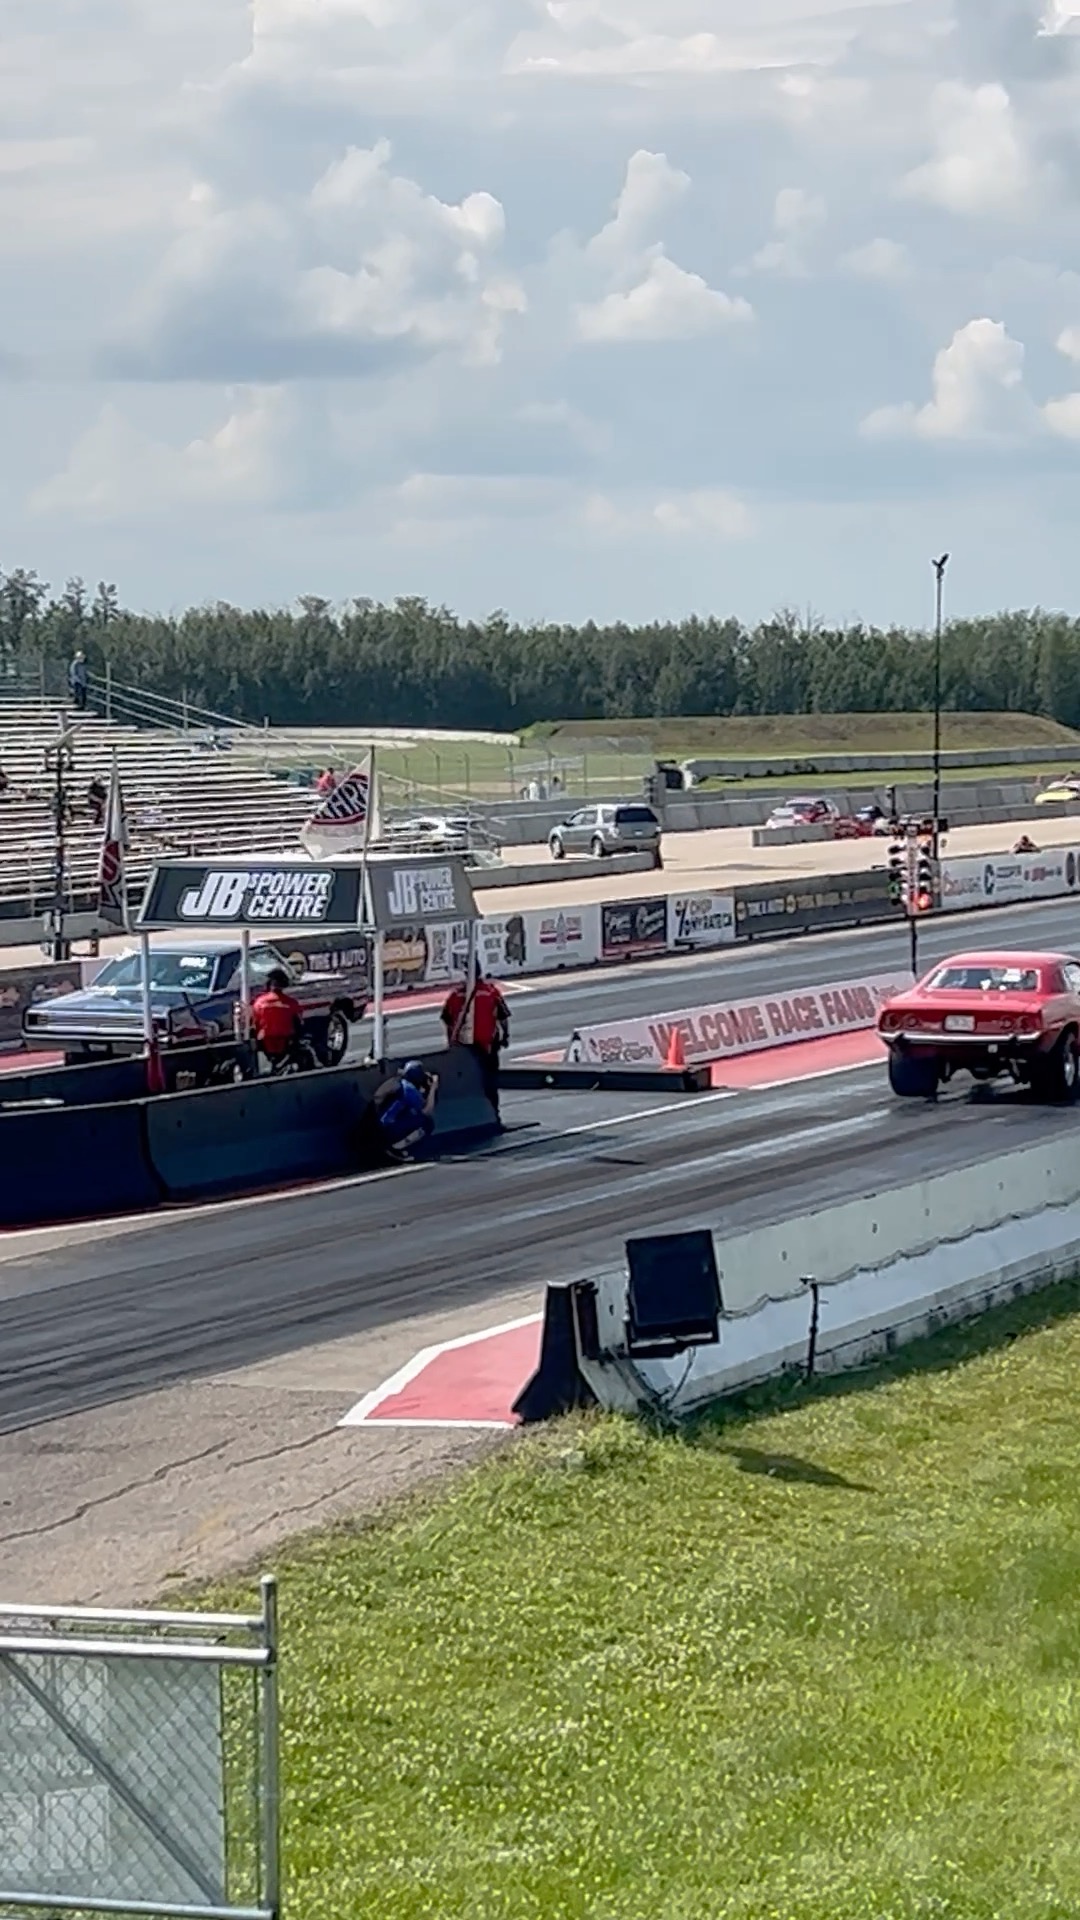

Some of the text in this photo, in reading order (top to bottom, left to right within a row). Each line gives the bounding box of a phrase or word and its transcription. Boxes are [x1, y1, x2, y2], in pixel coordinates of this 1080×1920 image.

[255, 872, 332, 894] POWER
[247, 895, 329, 918] CENTRE
[420, 888, 456, 912] CENTRE
[339, 948, 367, 968] AUTO
[648, 1005, 768, 1060] WELCOME
[765, 996, 823, 1036] RACE
[819, 986, 876, 1025] FANS
